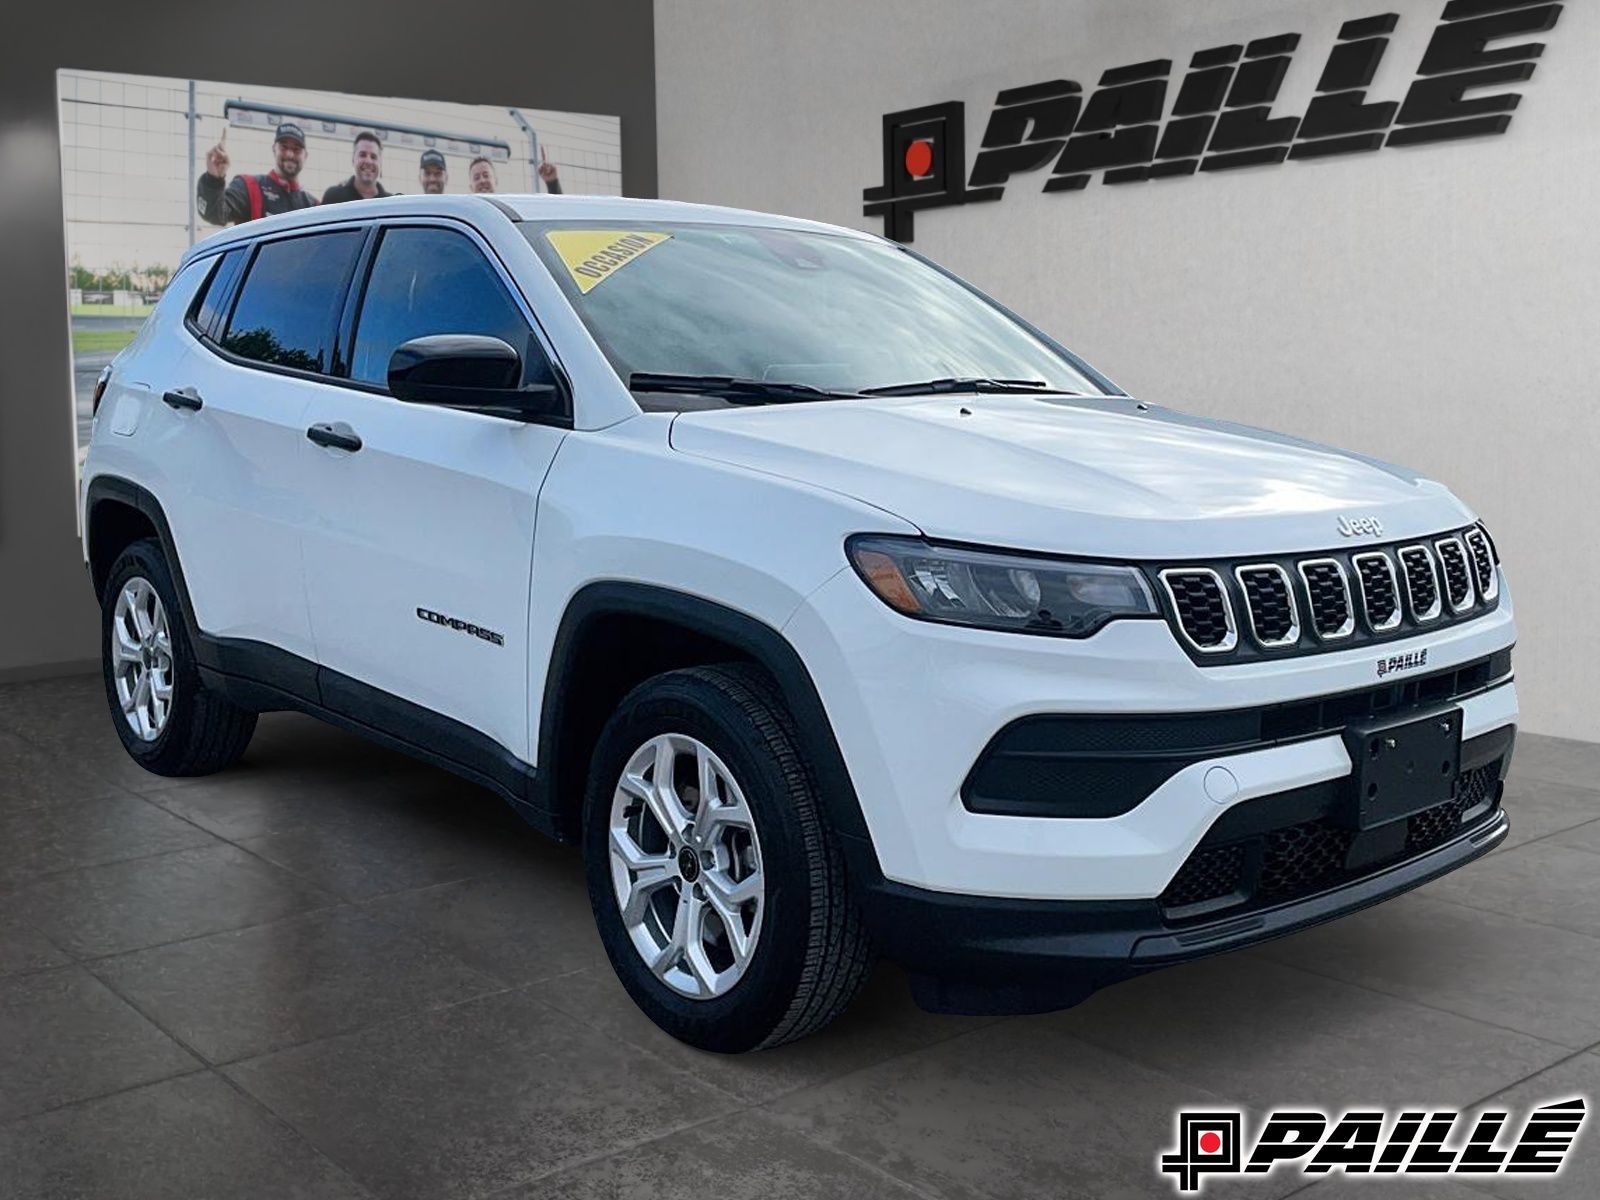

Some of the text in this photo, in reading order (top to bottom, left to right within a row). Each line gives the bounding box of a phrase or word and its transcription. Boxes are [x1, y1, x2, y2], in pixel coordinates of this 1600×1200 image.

[574, 233, 654, 279] OCCASION
[1337, 514, 1383, 537] Jeep
[416, 607, 505, 648] COMPASS
